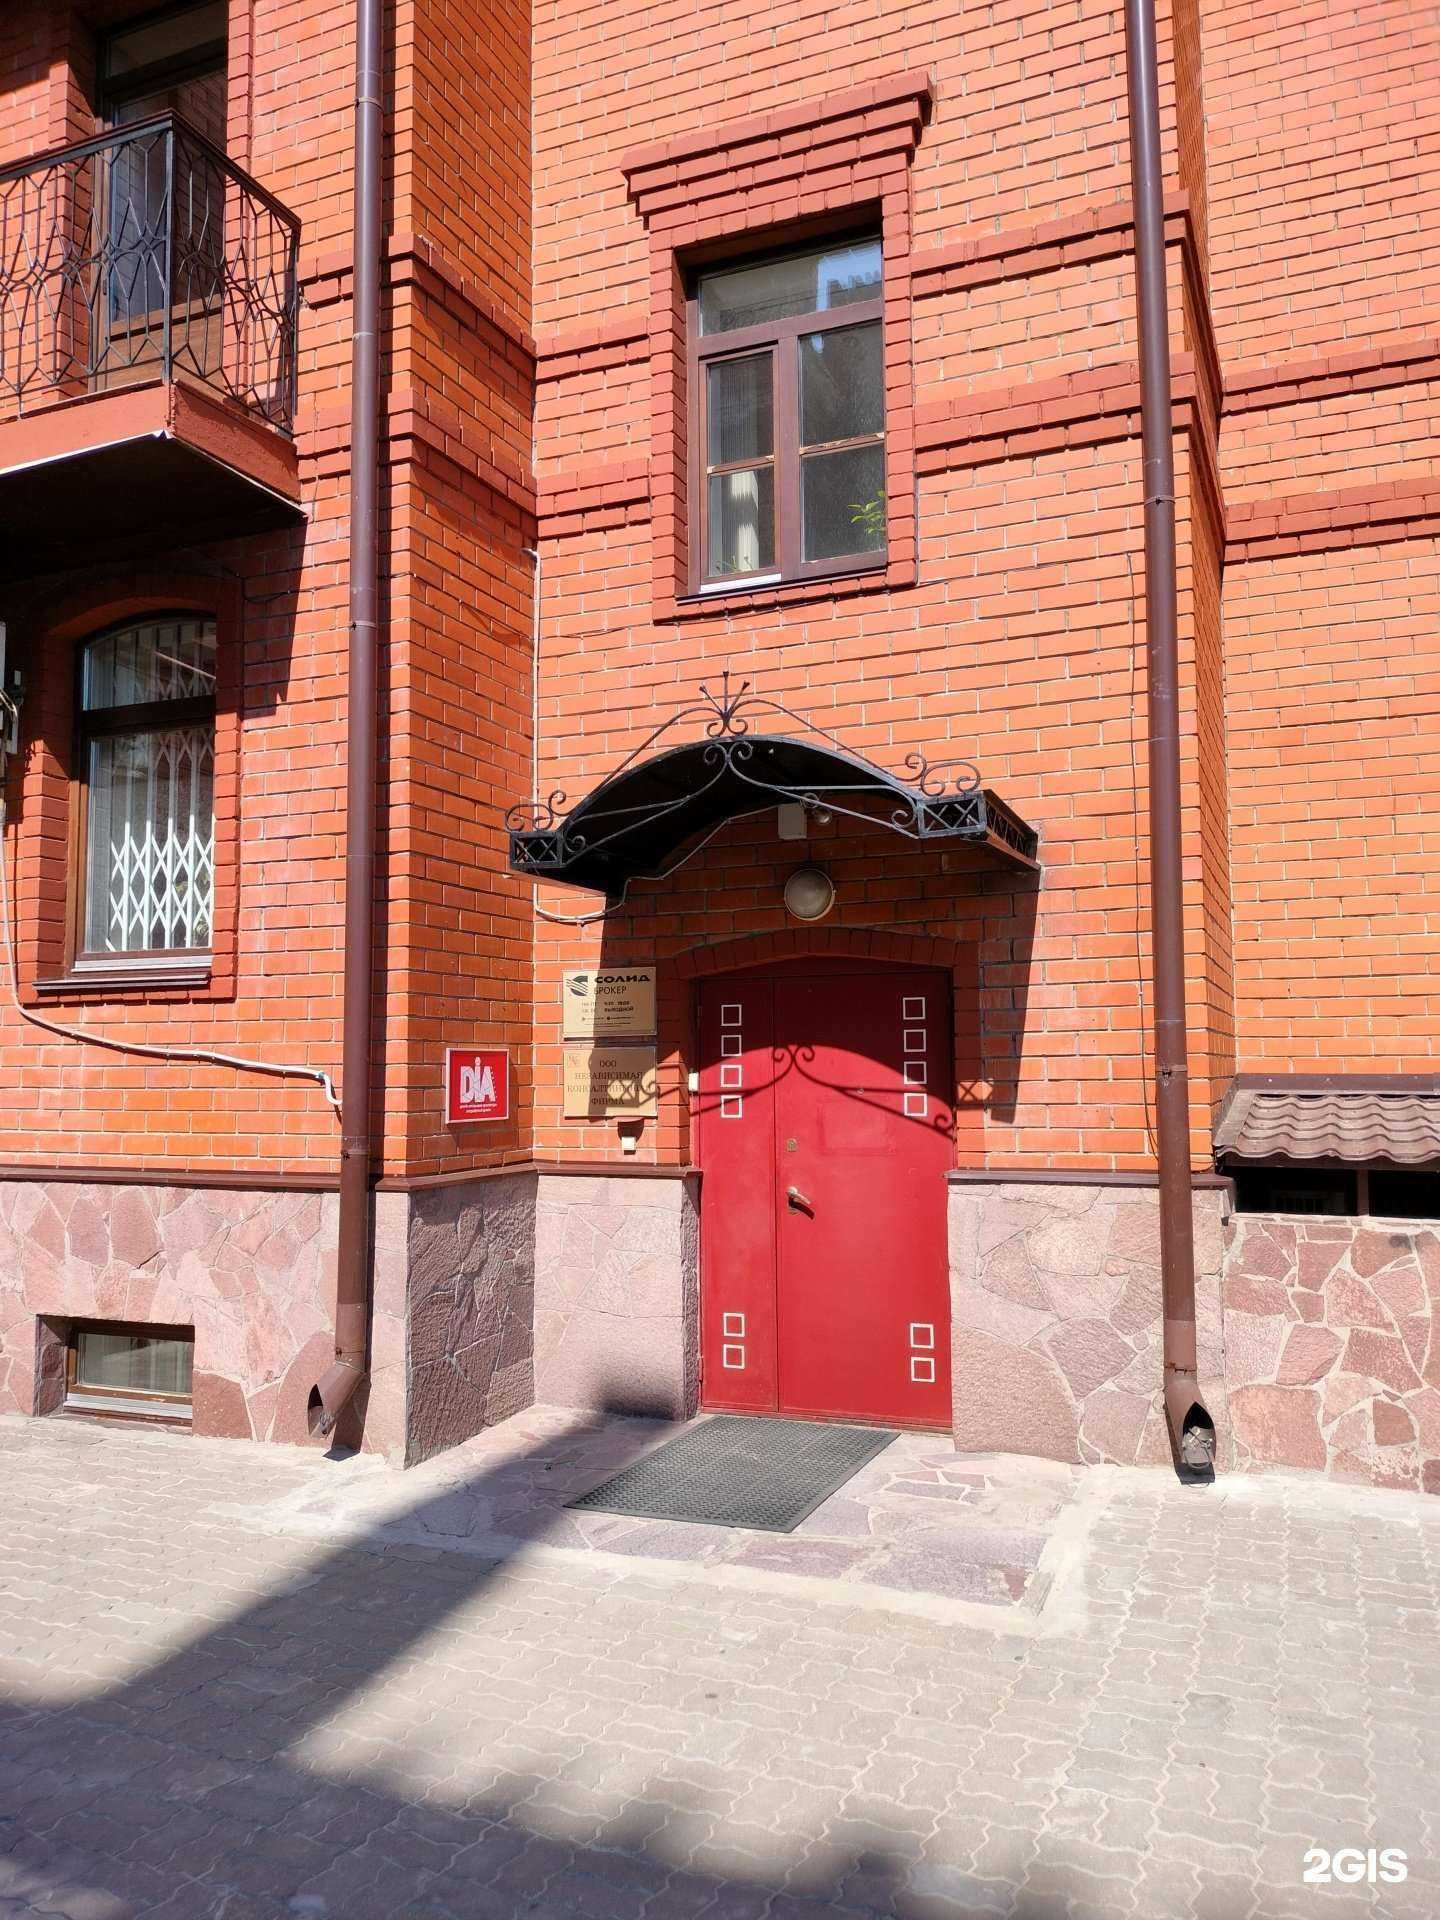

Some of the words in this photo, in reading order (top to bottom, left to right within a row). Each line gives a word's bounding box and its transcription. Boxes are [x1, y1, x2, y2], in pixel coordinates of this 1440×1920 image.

[594, 974, 651, 984] СОЛИД
[594, 986, 627, 996] БРОКЕР
[599, 1060, 617, 1068] ООО
